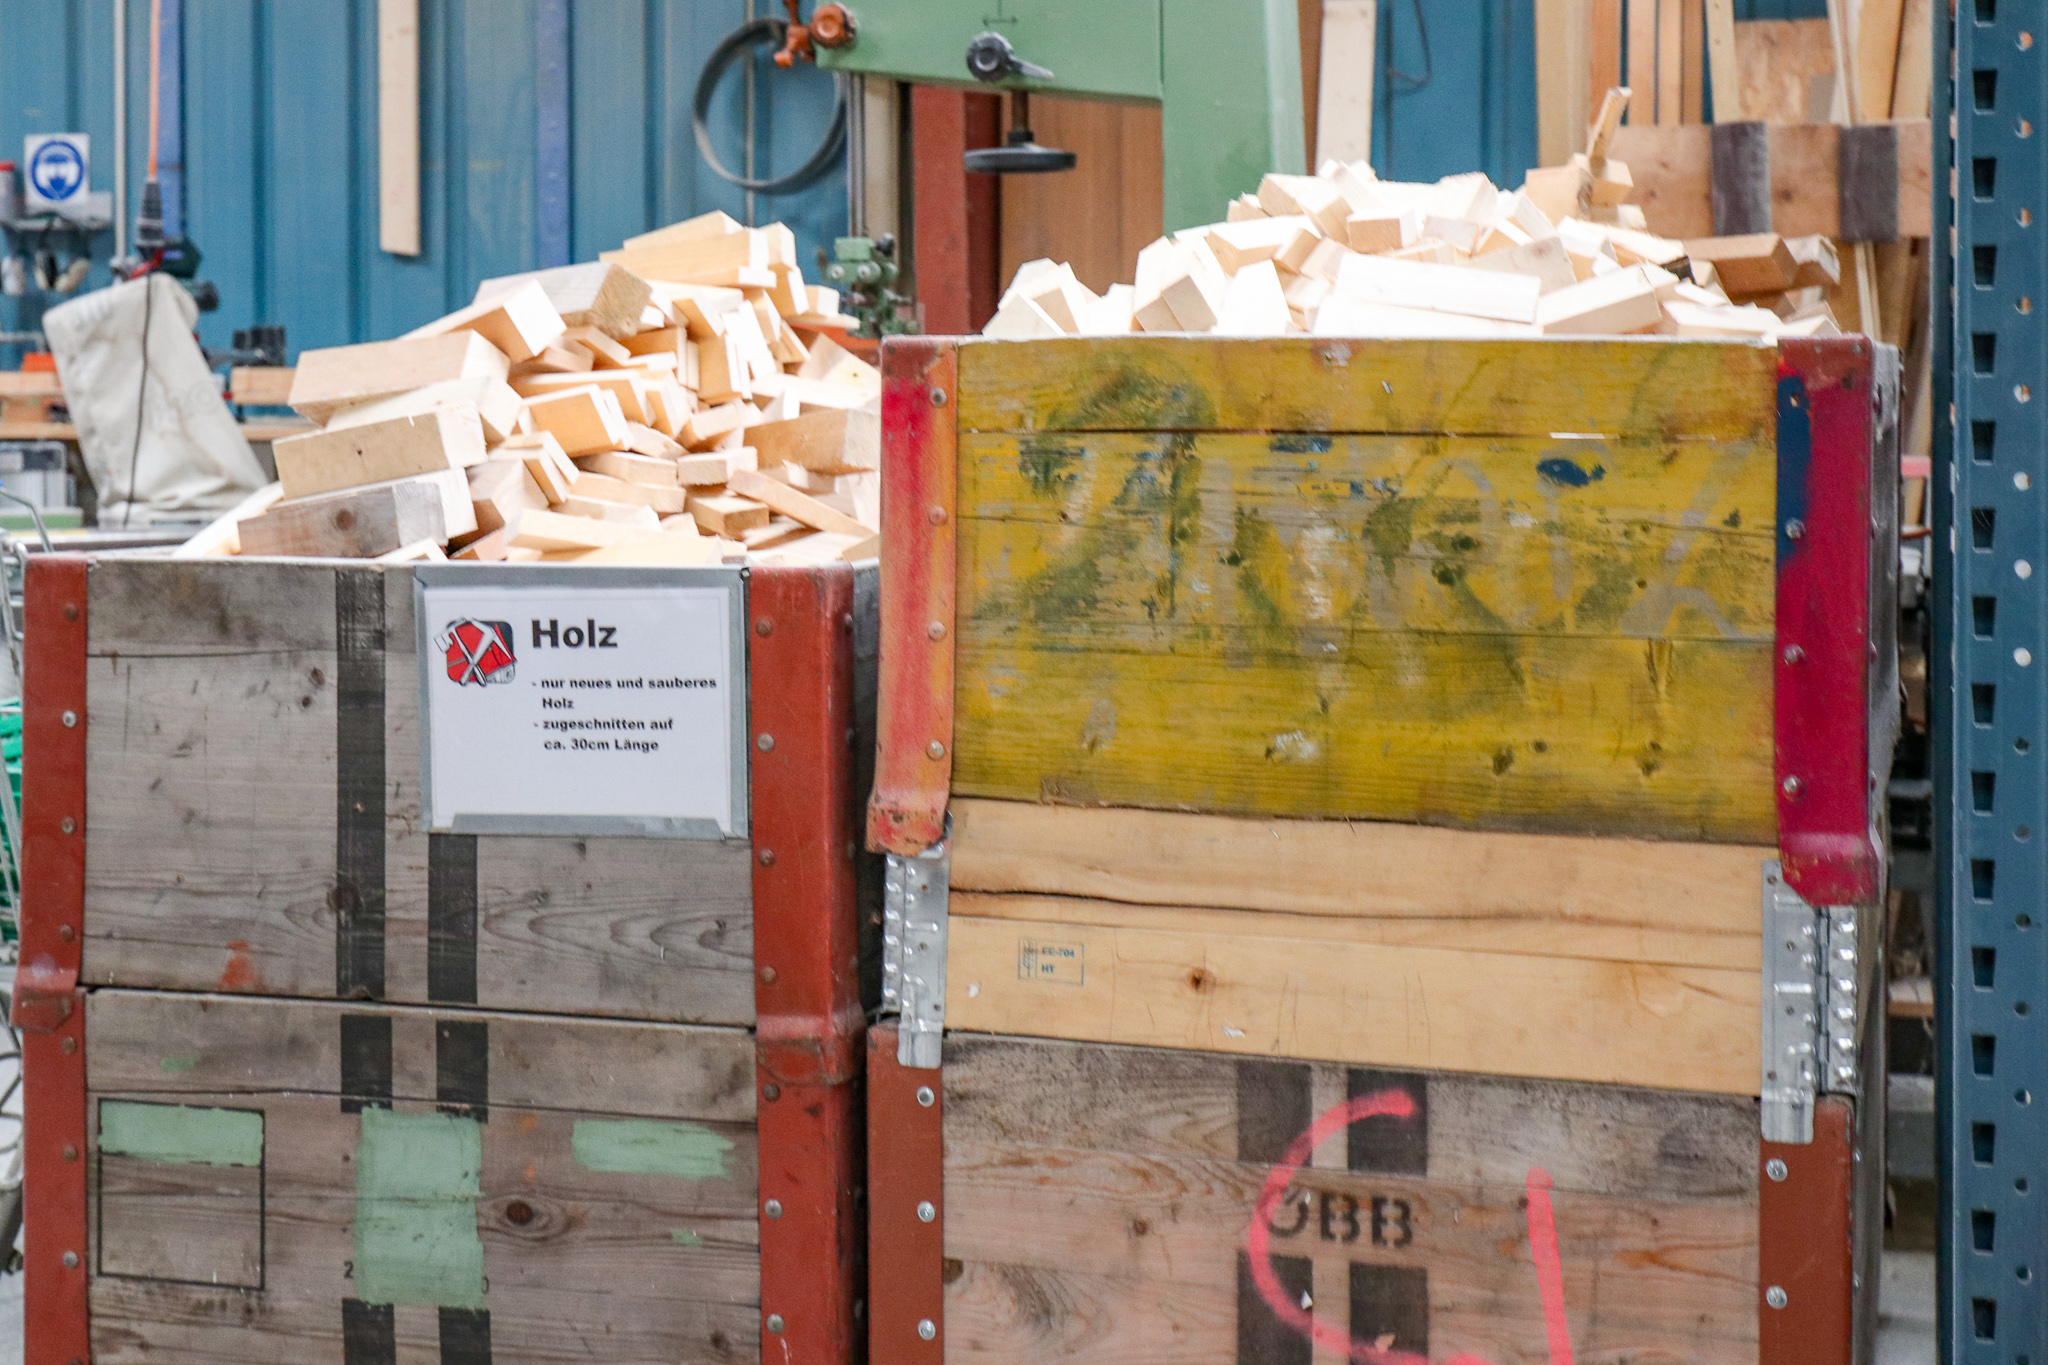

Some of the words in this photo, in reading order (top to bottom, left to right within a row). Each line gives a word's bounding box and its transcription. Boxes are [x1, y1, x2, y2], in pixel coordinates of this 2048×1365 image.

[531, 619, 618, 649] Holz
[541, 678, 565, 689] nur
[569, 678, 612, 689] neues
[617, 677, 643, 689] und
[648, 677, 717, 689] sauberes
[542, 697, 574, 710] Holz
[543, 718, 645, 732] zugeschnitten
[650, 718, 673, 730] auf
[544, 741, 566, 751] ca.
[571, 739, 610, 751] 30cm
[614, 739, 660, 753] Länge
